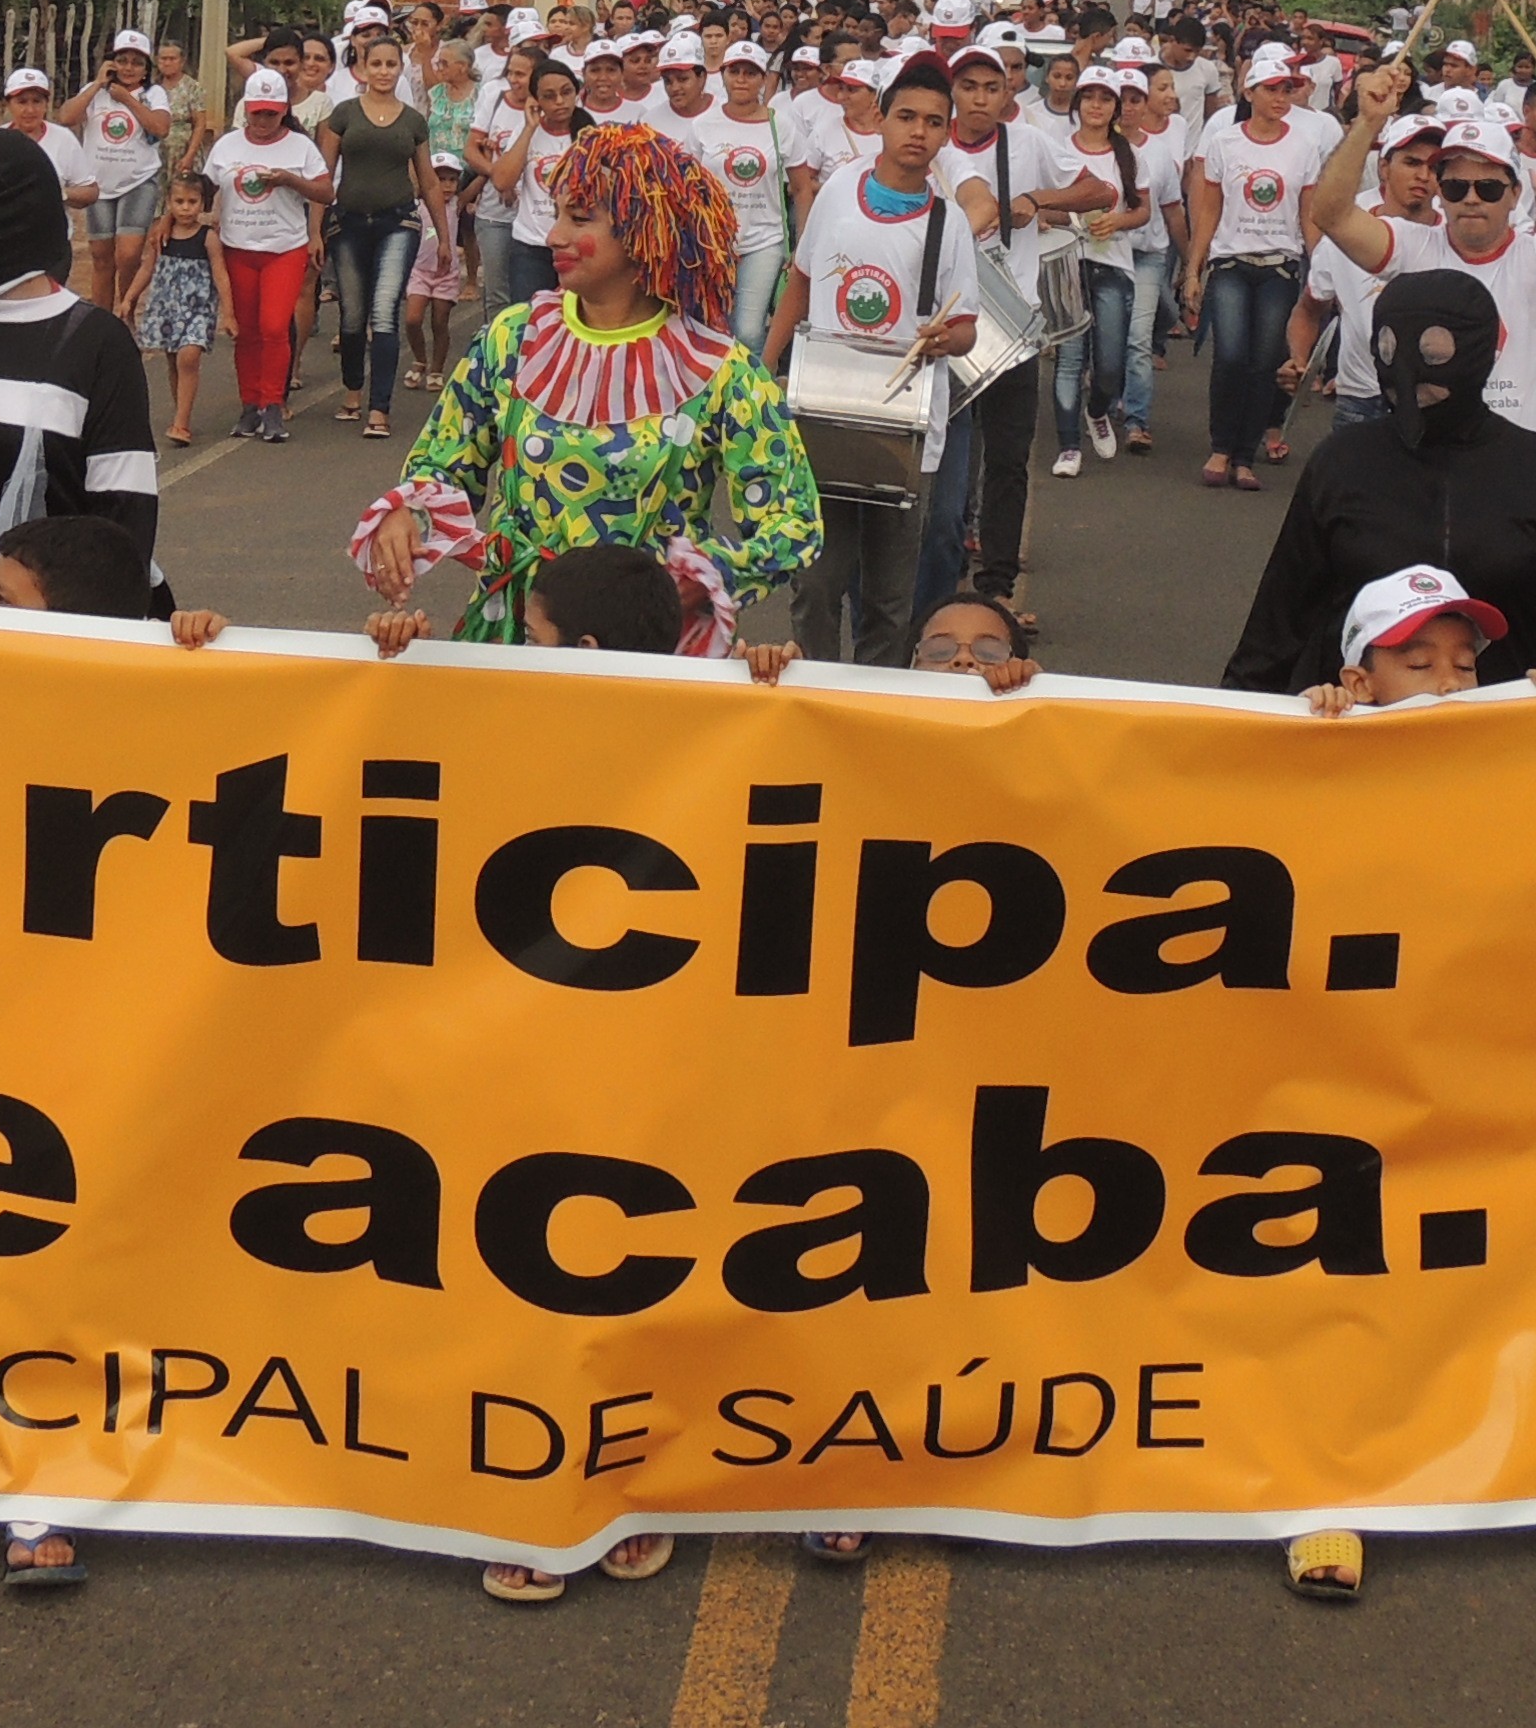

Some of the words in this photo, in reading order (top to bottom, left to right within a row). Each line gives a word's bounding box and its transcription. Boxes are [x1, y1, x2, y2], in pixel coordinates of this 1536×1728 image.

[230, 1085, 1487, 1316] acaba.
[469, 1390, 653, 1480] DE
[712, 1356, 1205, 1466] SAÚDE
